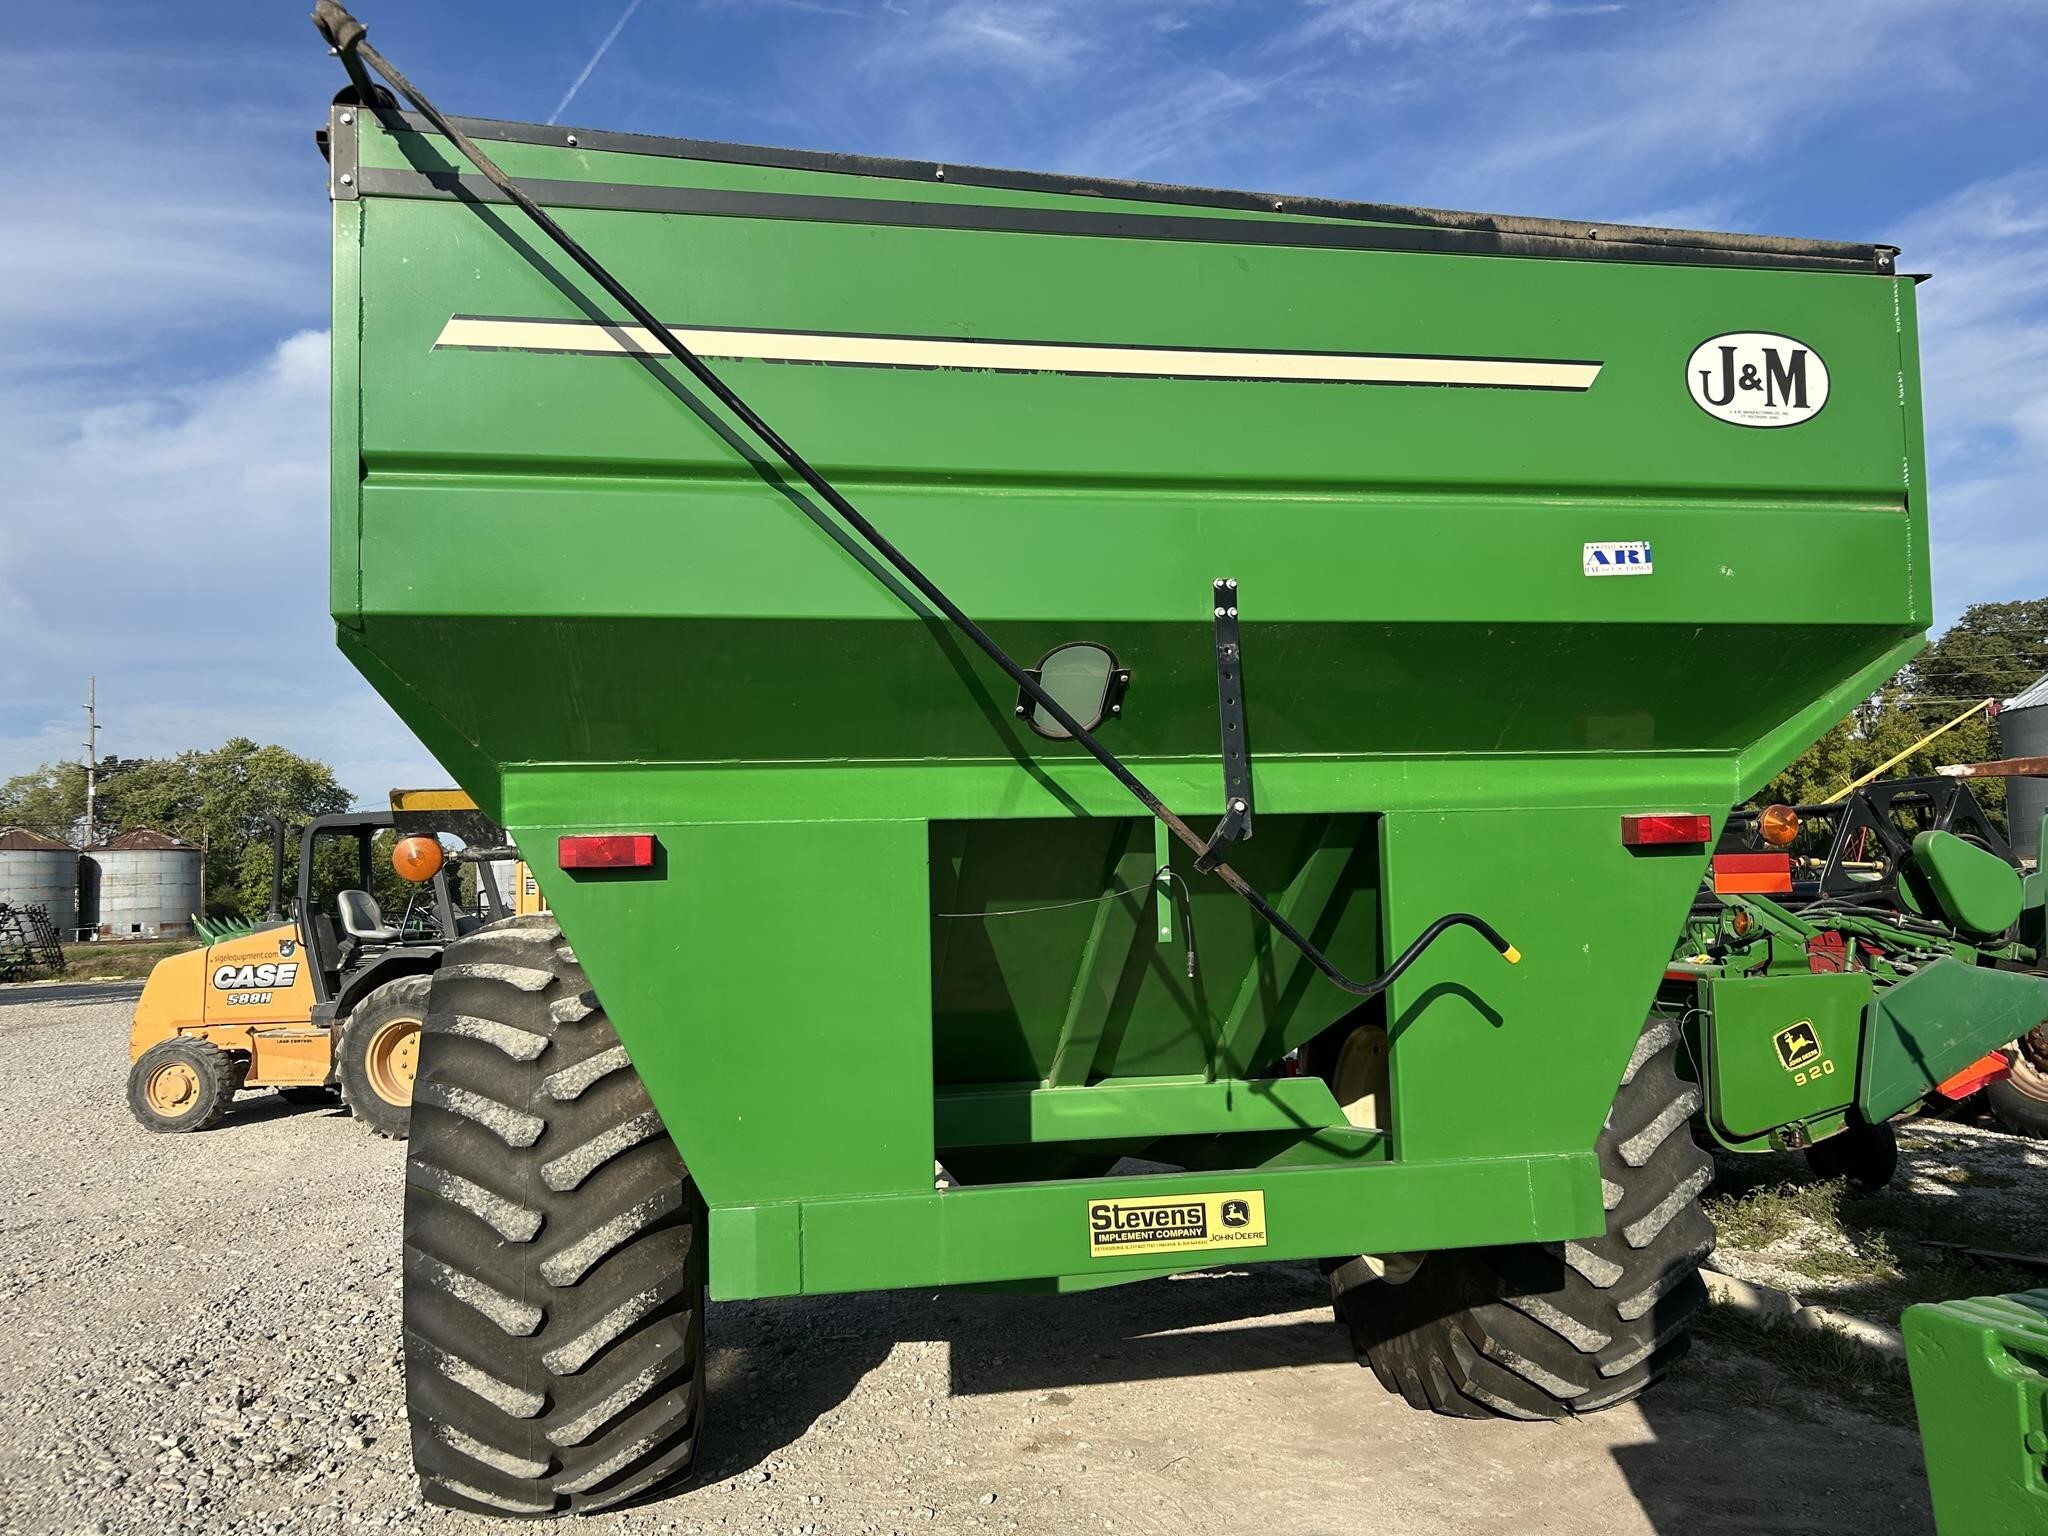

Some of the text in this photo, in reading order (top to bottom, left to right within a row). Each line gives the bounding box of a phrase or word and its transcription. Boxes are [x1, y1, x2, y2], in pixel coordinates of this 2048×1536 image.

[1698, 346, 1811, 408] J&M
[214, 951, 279, 963] sigelequipment.com
[213, 963, 299, 990] CASE
[227, 992, 272, 1005] 588H
[1788, 1049, 1819, 1067] JOHN DEERE
[1794, 1059, 1835, 1087] 920
[1091, 1204, 1202, 1231] Stevens
[1098, 1228, 1203, 1242] IMPLEMENT COMPANY
[1209, 1231, 1265, 1242] JOHN DEERE
